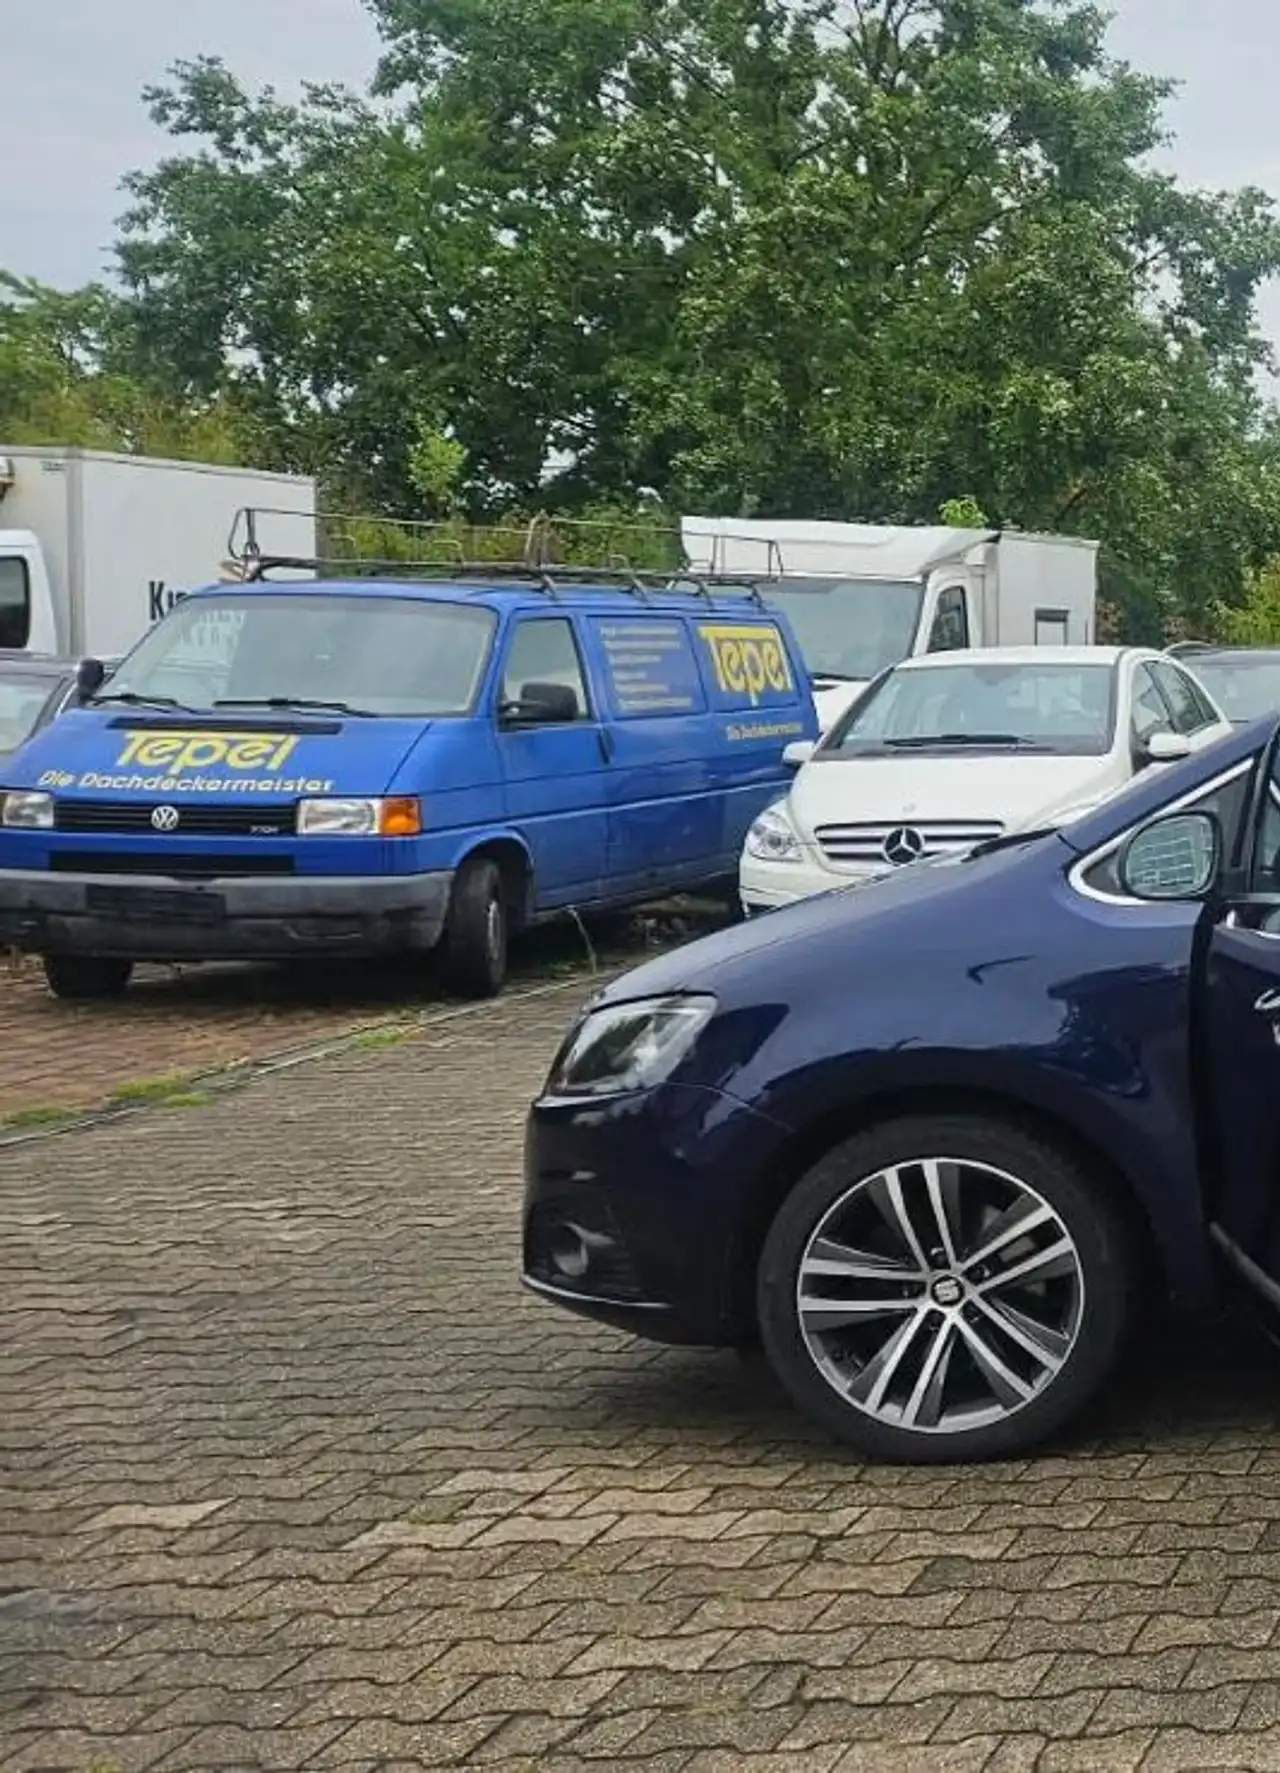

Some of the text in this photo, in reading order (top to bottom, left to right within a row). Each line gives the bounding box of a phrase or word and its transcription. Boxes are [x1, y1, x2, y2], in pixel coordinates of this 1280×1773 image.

[698, 626, 794, 706] Tepel
[116, 730, 301, 775] Tepel
[37, 770, 337, 793] Die Dachdeckermeister
